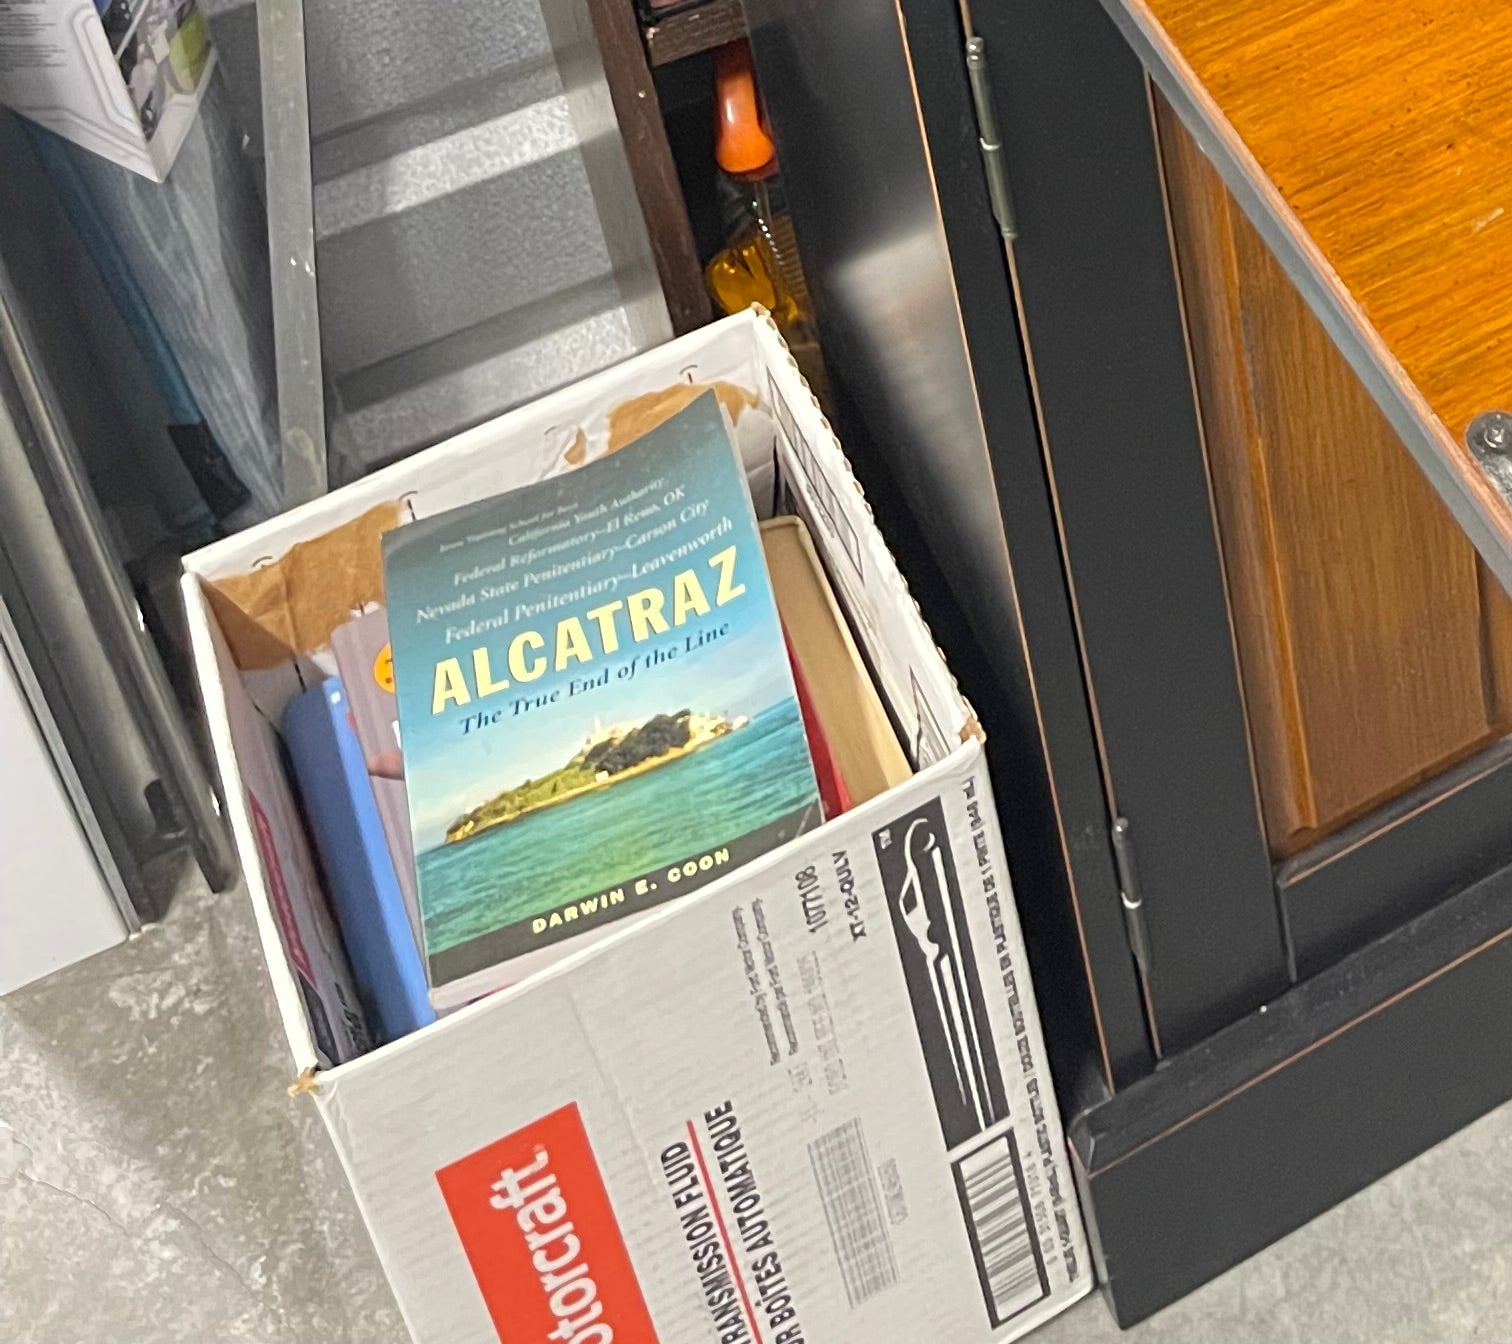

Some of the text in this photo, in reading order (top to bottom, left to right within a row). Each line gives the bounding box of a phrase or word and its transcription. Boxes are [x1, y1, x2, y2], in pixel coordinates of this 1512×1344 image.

[416, 592, 476, 624] Nevada
[480, 580, 519, 602] State
[680, 497, 710, 524] City
[453, 558, 506, 586] Federal
[431, 545, 746, 716] ALCATRAZ
[445, 612, 509, 645] Federal
[459, 621, 730, 736] The True End of the Line
[531, 846, 732, 937] DARWIN E. COON
[795, 865, 829, 934] 1077108
[832, 850, 867, 942] XT-12-QULV
[660, 1141, 705, 1210] FLUID
[704, 1099, 775, 1253] AUTOMATIQUE
[752, 1250, 797, 1329] BOÎTES
